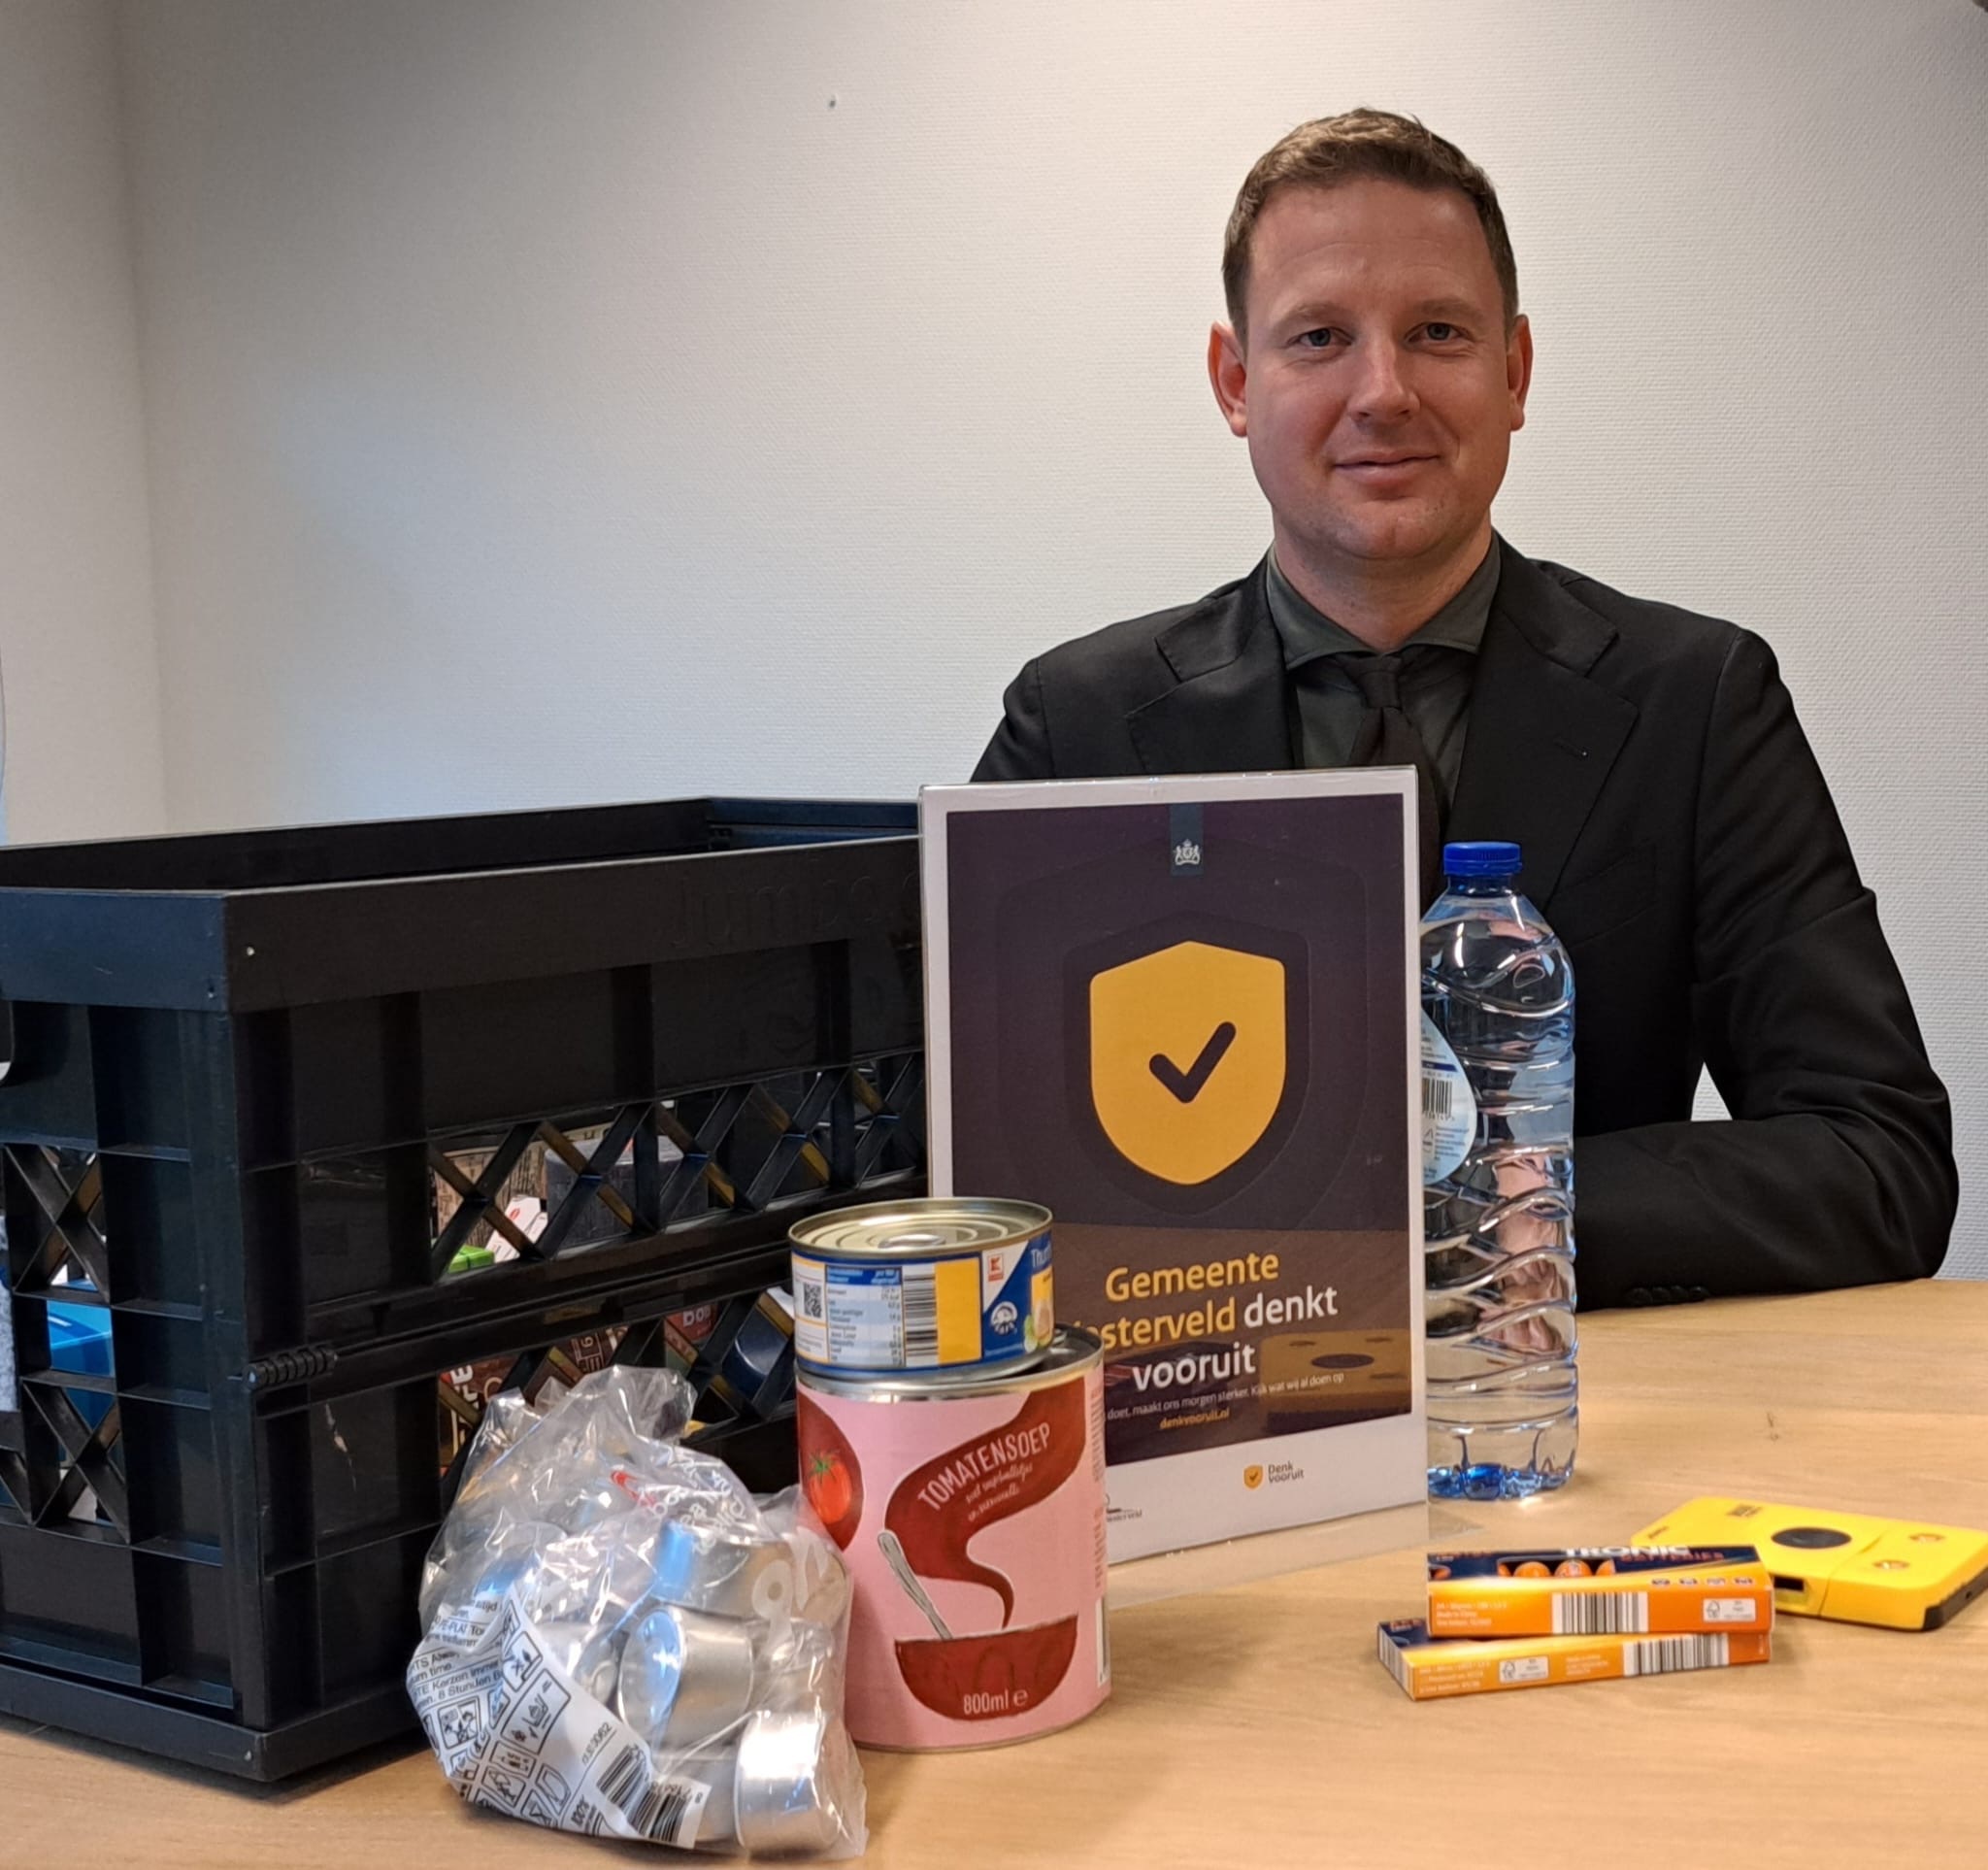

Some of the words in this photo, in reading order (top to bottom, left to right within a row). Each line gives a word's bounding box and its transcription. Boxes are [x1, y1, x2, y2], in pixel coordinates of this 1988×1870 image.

[1106, 1251, 1279, 1302] Gemeente
[1074, 1297, 1236, 1351] sterveld
[1243, 1285, 1338, 1328] denkt
[1133, 1341, 1256, 1392] vooruit
[1133, 1402, 1162, 1416] maakt
[1164, 1398, 1179, 1411] ons
[1181, 1393, 1216, 1408] morgen
[1268, 1382, 1284, 1392] wat
[1300, 1378, 1309, 1388] al
[1309, 1375, 1332, 1386] doen
[1333, 1373, 1344, 1385] op
[918, 1422, 1051, 1511] TOMATENSOEP
[1268, 1460, 1293, 1474] Denk
[1268, 1468, 1305, 1484] vooruit
[433, 1672, 468, 1690] Kerzen
[447, 1676, 490, 1696] Stunden
[964, 1688, 1009, 1715] 800ml
